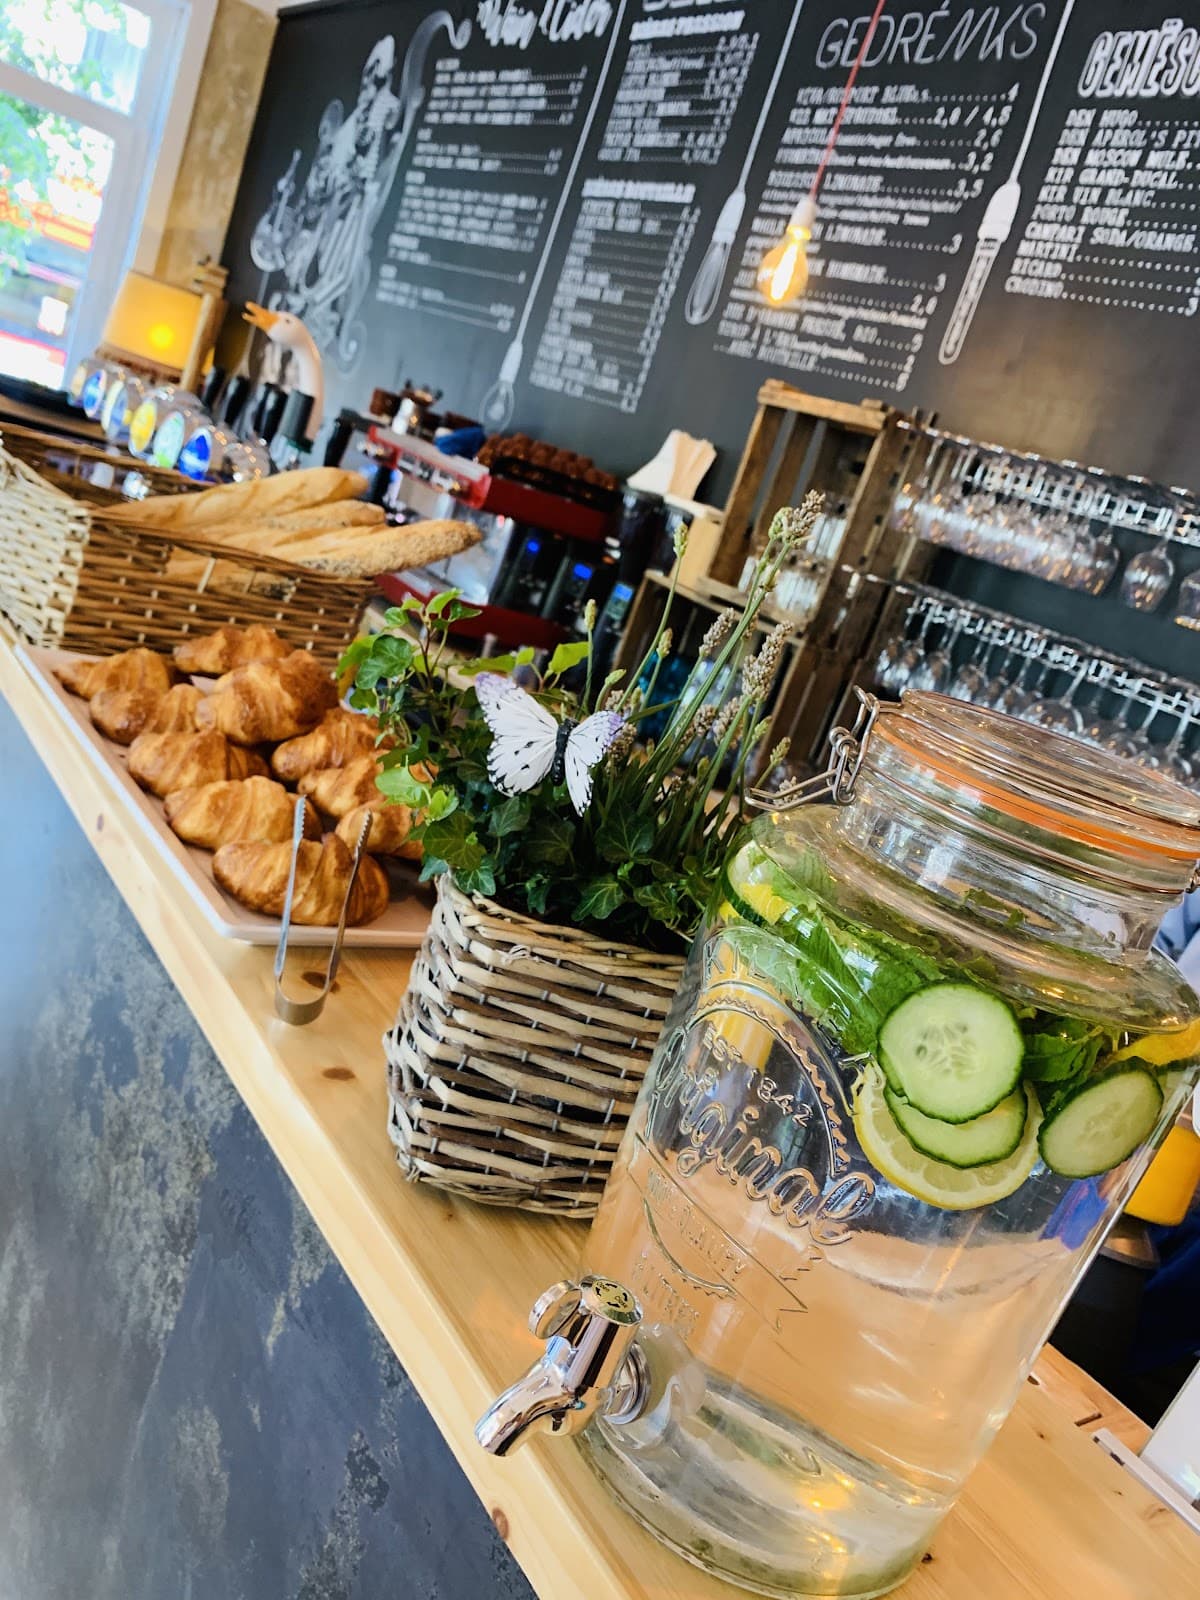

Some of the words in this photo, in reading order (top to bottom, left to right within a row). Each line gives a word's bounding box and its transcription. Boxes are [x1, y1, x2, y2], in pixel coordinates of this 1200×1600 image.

[815, 0, 1046, 69] GEDRÉNKS
[1016, 239, 1078, 262] MARTINI
[1025, 221, 1086, 244] CAMPARI
[746, 1068, 814, 1128] 1842
[655, 1026, 876, 1246] Original
